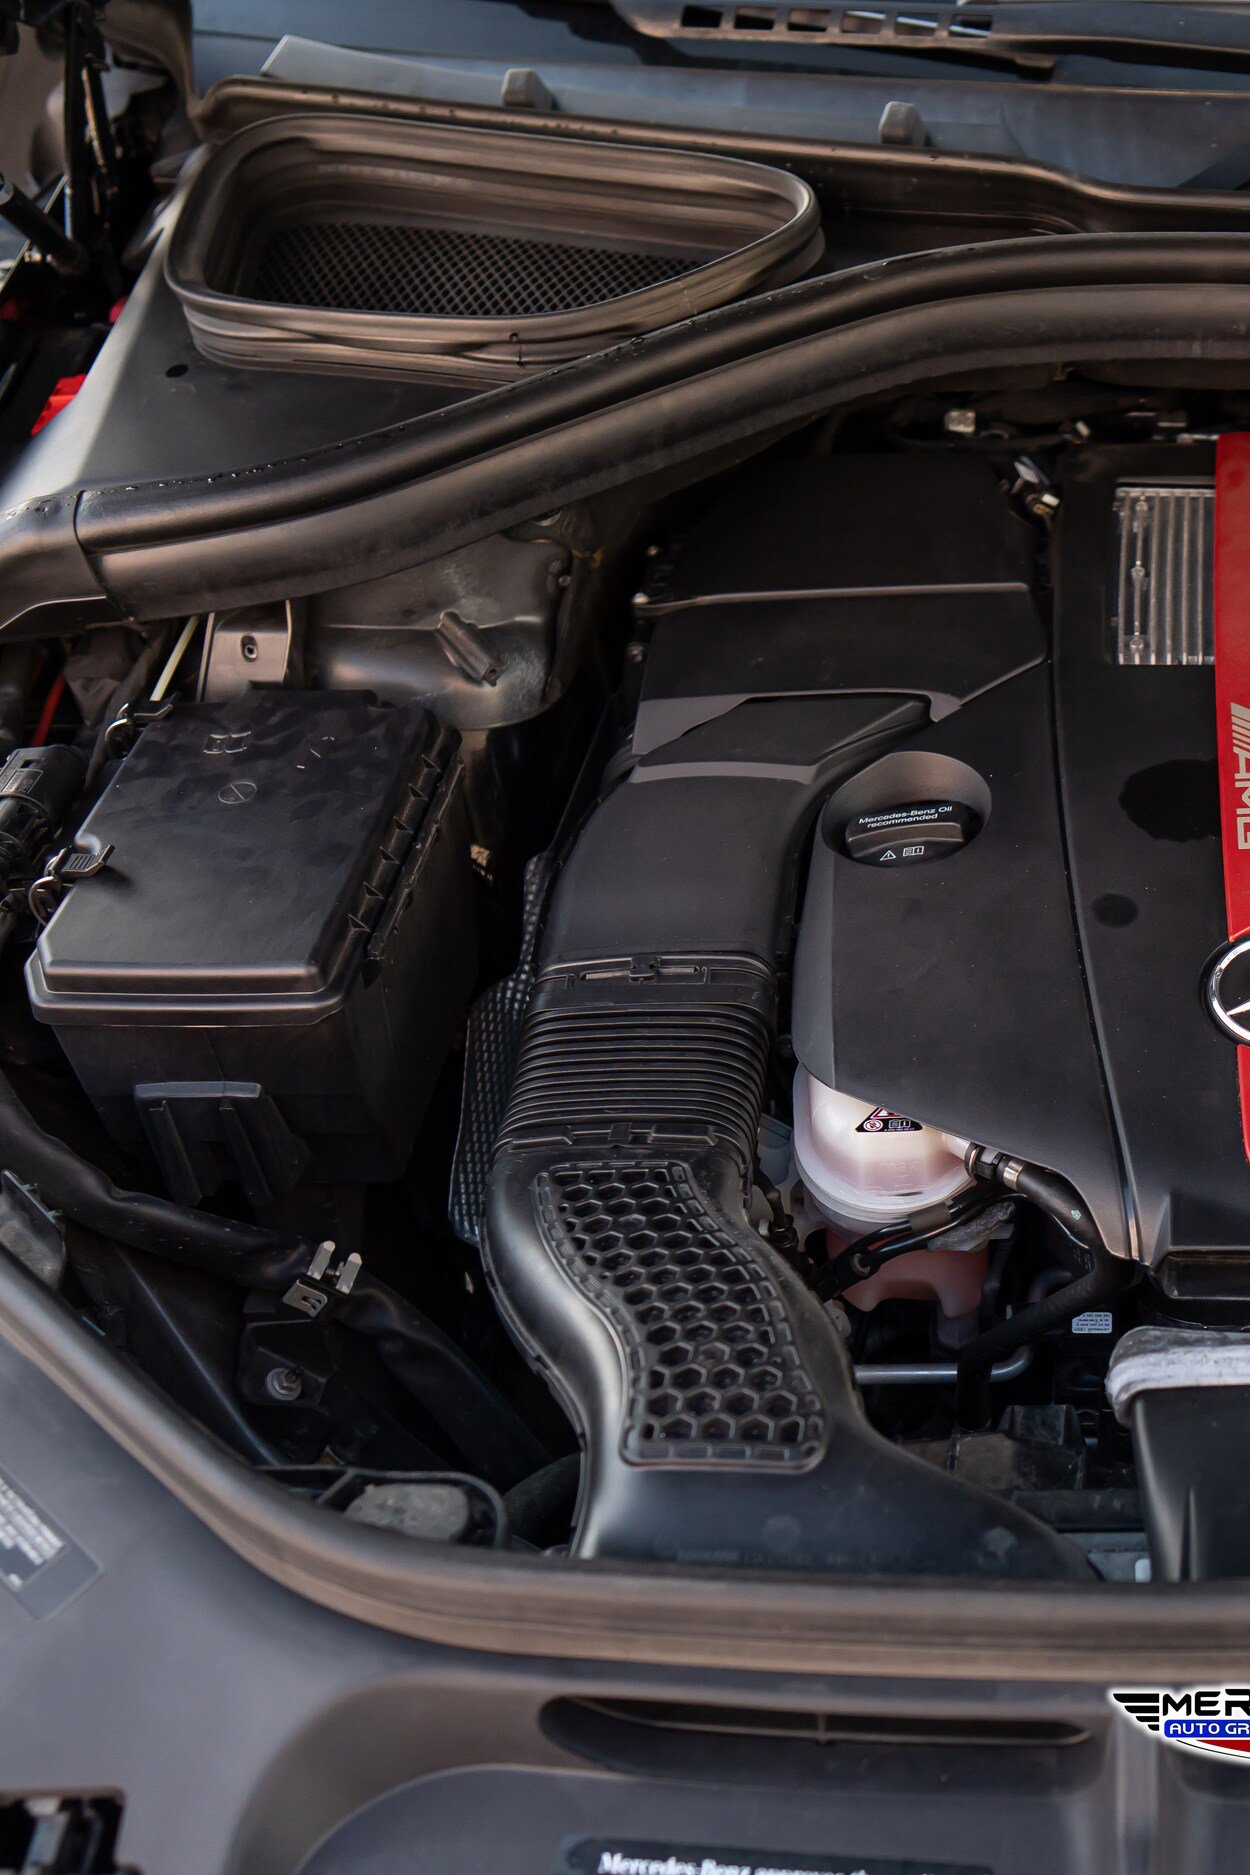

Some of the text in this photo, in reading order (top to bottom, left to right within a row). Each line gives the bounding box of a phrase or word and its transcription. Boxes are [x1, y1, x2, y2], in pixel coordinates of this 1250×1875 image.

[858, 805, 953, 825] Mercedes-Benz Oil
[867, 813, 939, 828] recommended
